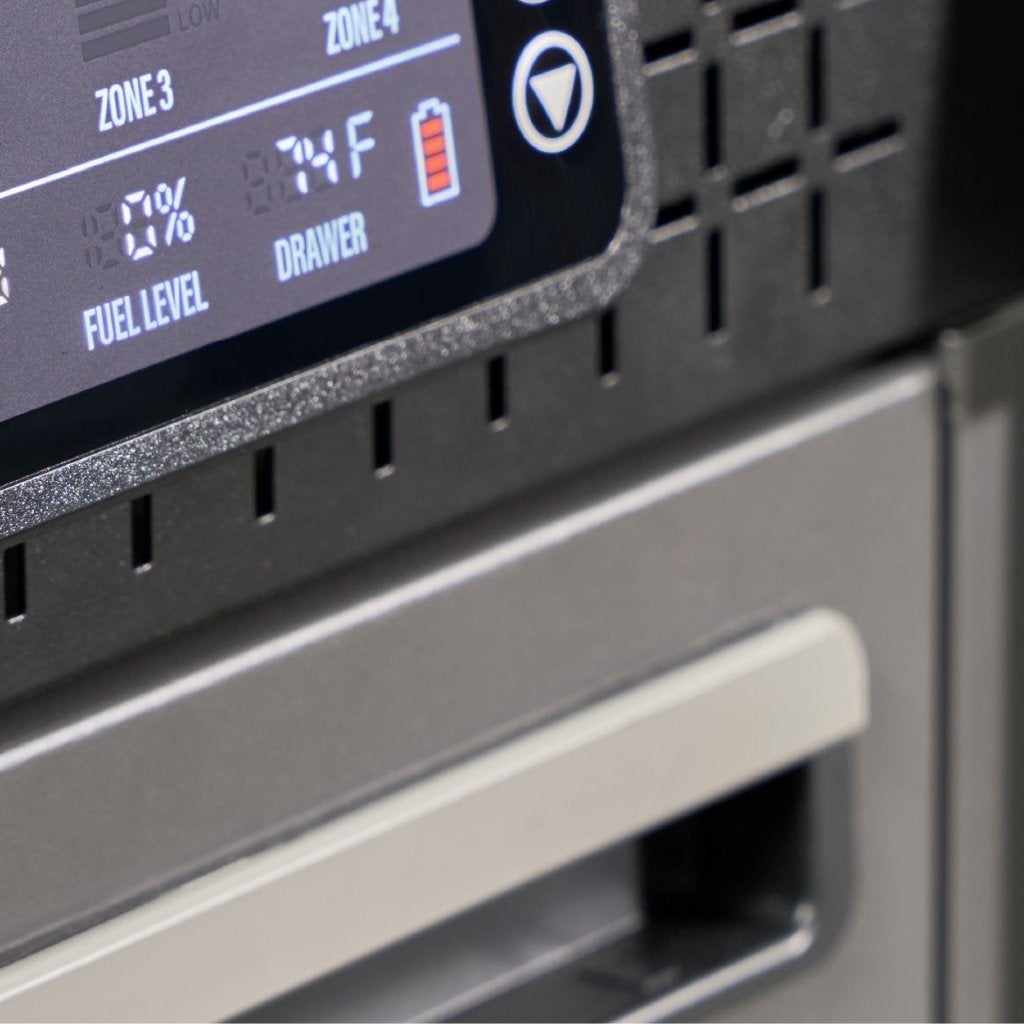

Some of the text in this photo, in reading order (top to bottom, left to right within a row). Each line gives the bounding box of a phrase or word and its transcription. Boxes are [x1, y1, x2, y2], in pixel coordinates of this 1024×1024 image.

[95, 68, 175, 132] ZONE 3
[274, 211, 368, 282] DRAWER
[82, 269, 210, 351] FUEL LEVEL
